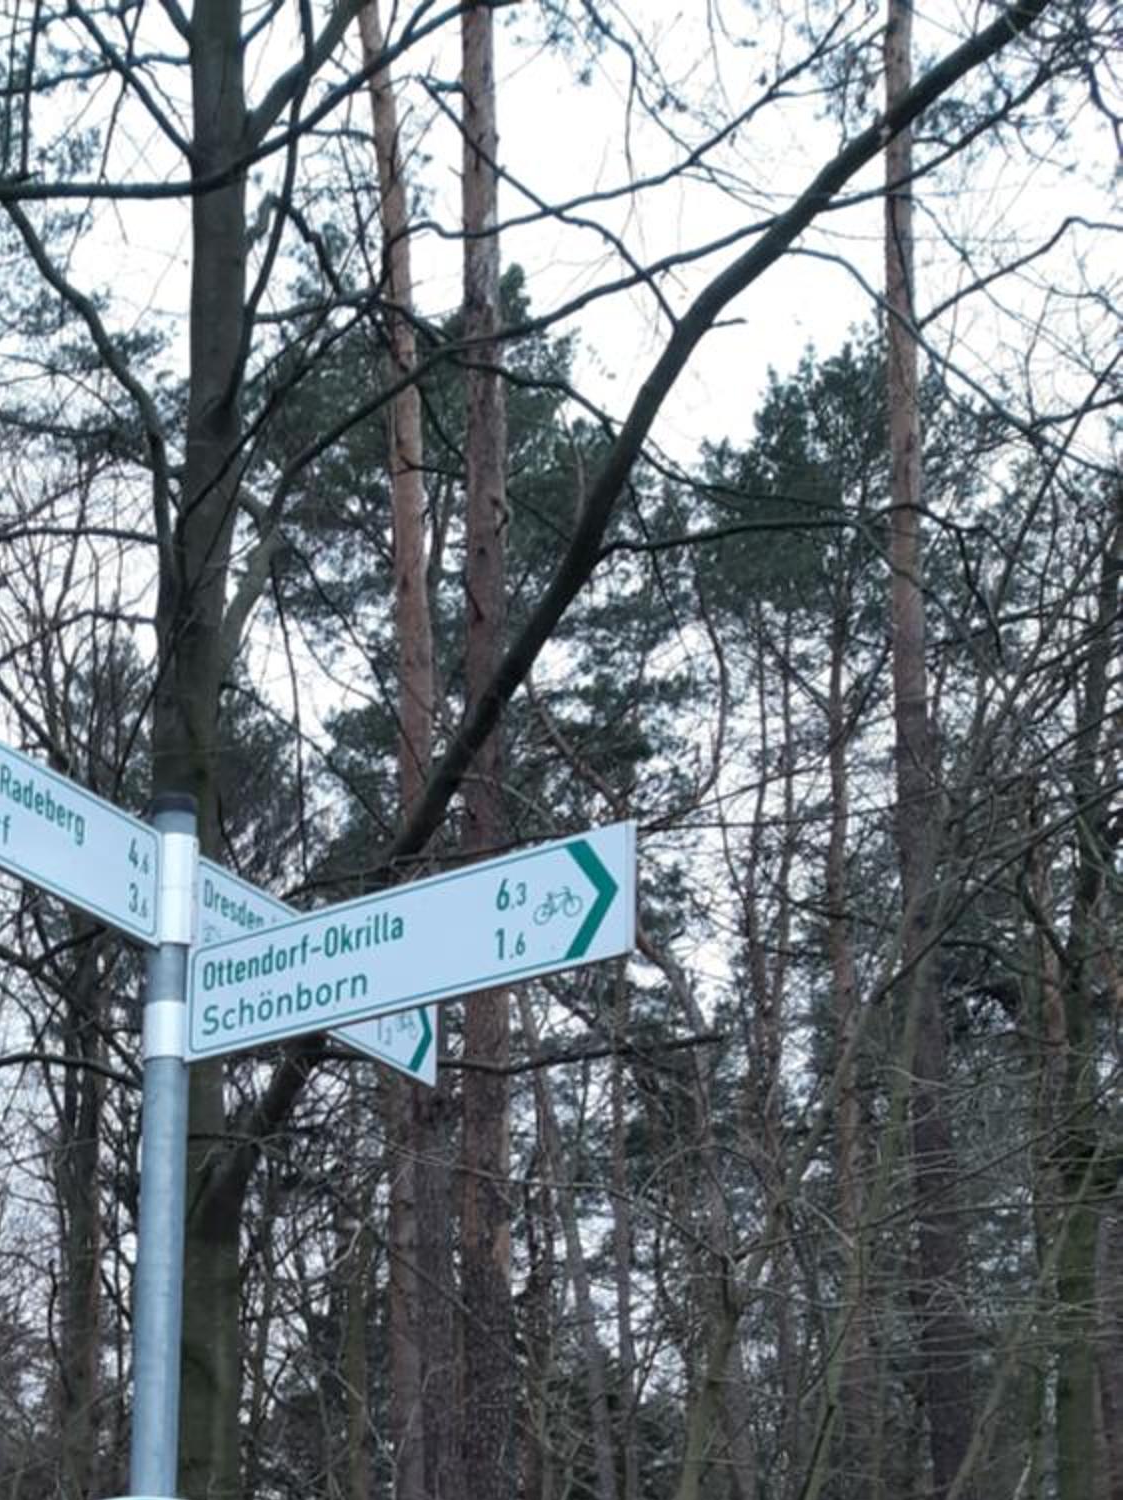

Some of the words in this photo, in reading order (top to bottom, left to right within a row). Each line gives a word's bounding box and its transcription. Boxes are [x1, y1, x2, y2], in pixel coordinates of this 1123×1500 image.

[203, 878, 264, 930] Dresden
[202, 912, 404, 992] Ottendorf-Okrilla
[202, 973, 368, 1036] Schönborn
